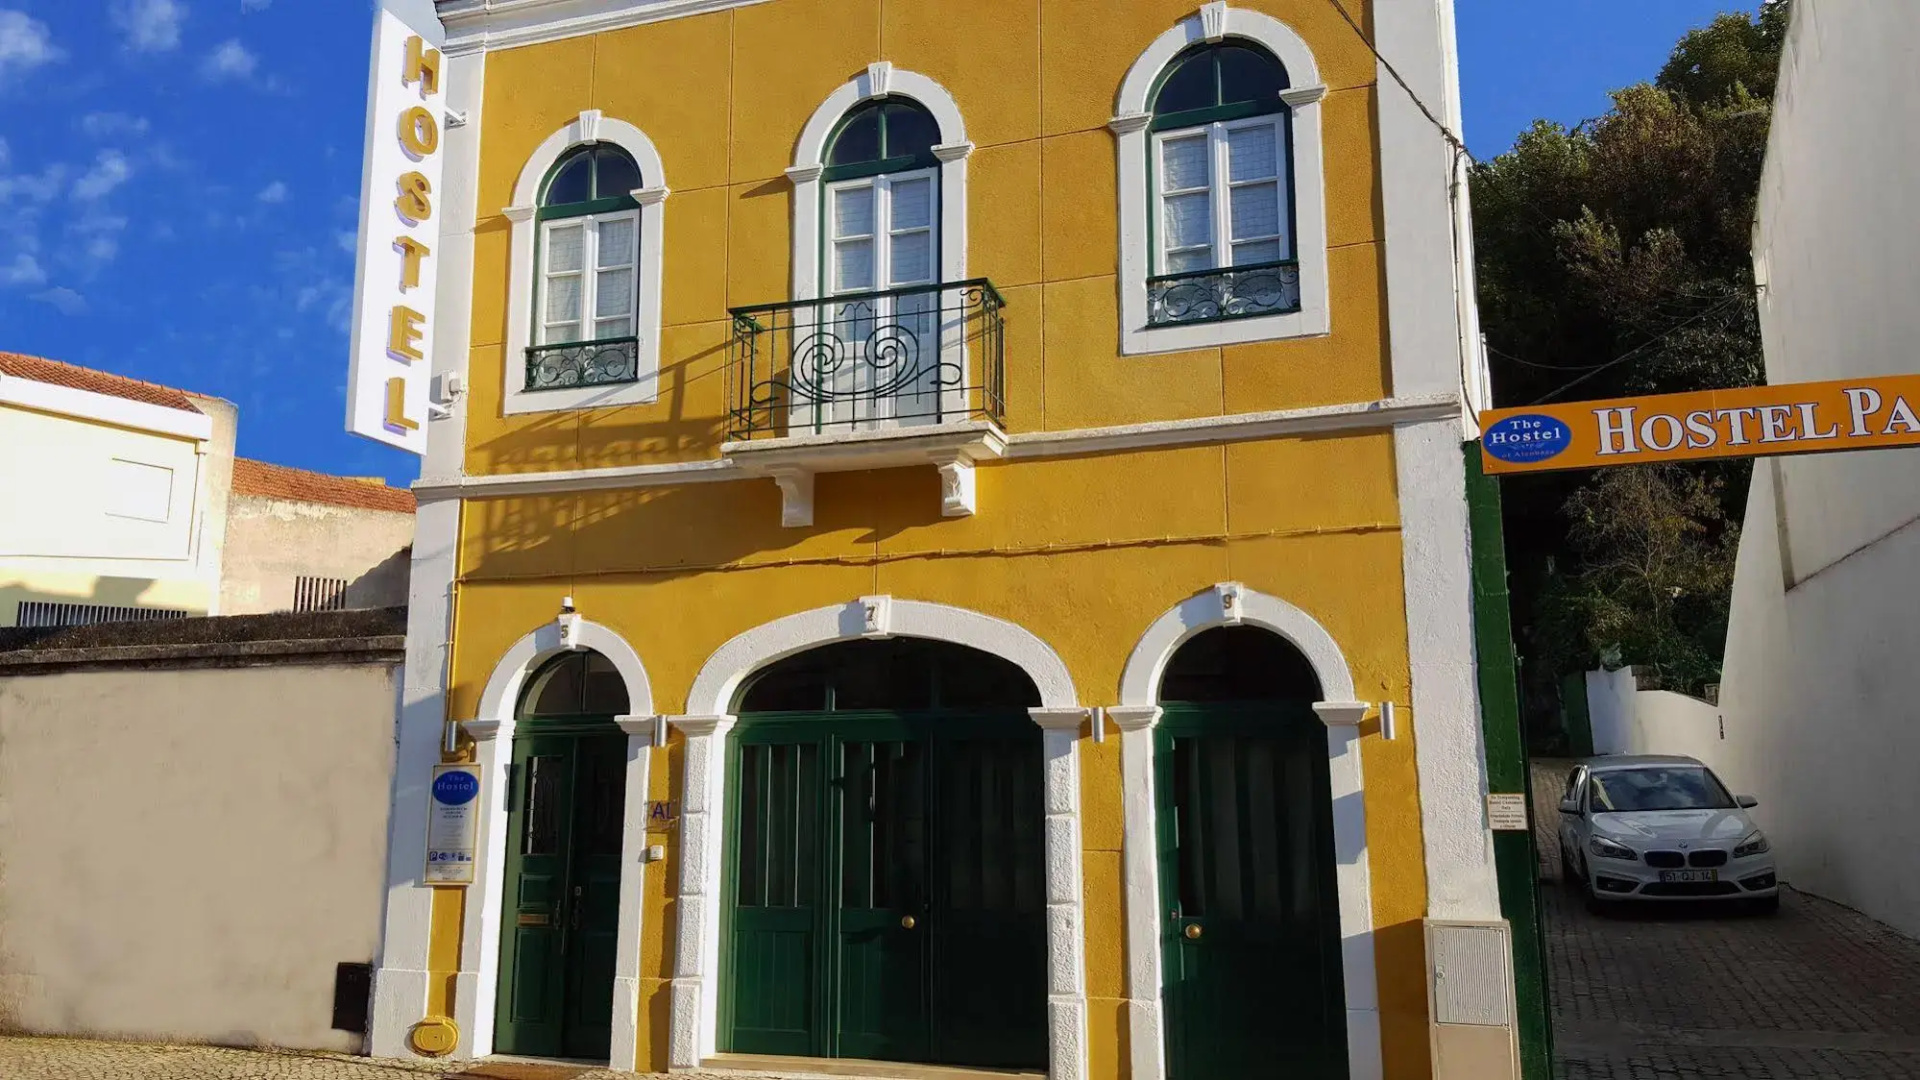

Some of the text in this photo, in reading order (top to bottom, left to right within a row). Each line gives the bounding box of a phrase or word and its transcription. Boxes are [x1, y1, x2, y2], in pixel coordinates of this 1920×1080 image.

[385, 35, 440, 432] HOSTEL
[1510, 420, 1541, 430] The
[1592, 387, 1920, 455] HOSTEL PA
[1491, 428, 1561, 444] Hostel
[1223, 594, 1232, 609] 9
[865, 606, 875, 621] 7
[561, 625, 568, 638] 5
[437, 782, 474, 790] Hostel
[652, 802, 677, 819] AL
